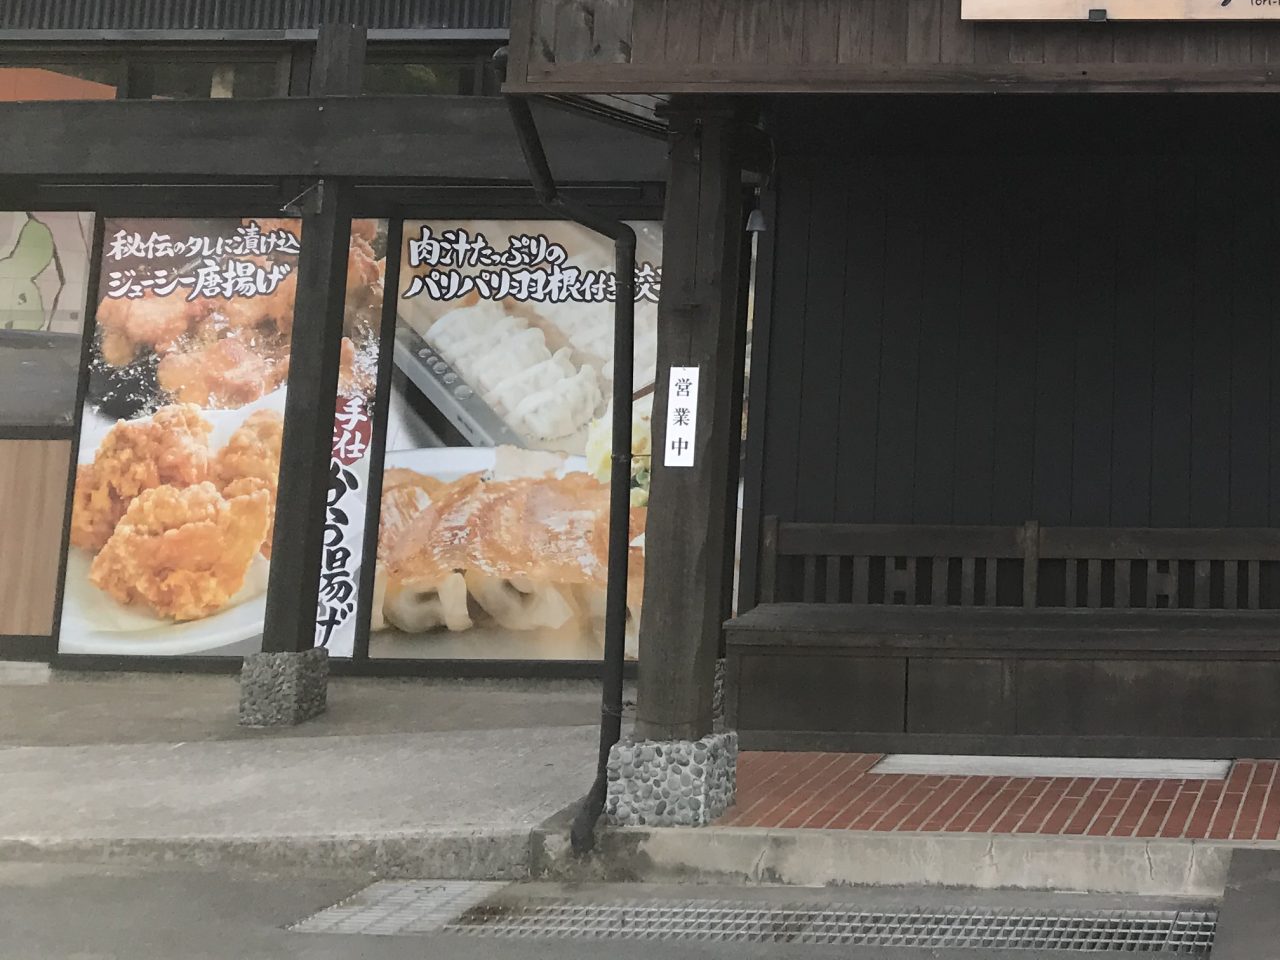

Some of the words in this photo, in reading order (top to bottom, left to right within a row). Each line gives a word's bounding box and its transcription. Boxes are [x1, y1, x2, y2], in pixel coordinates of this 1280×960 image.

[106, 222, 301, 260] 秘伝のタレに漬け込
[409, 226, 567, 267] 肉汁たっぷりの
[107, 258, 291, 302] ジューシー唐揚げ
[671, 377, 693, 456] 営業中
